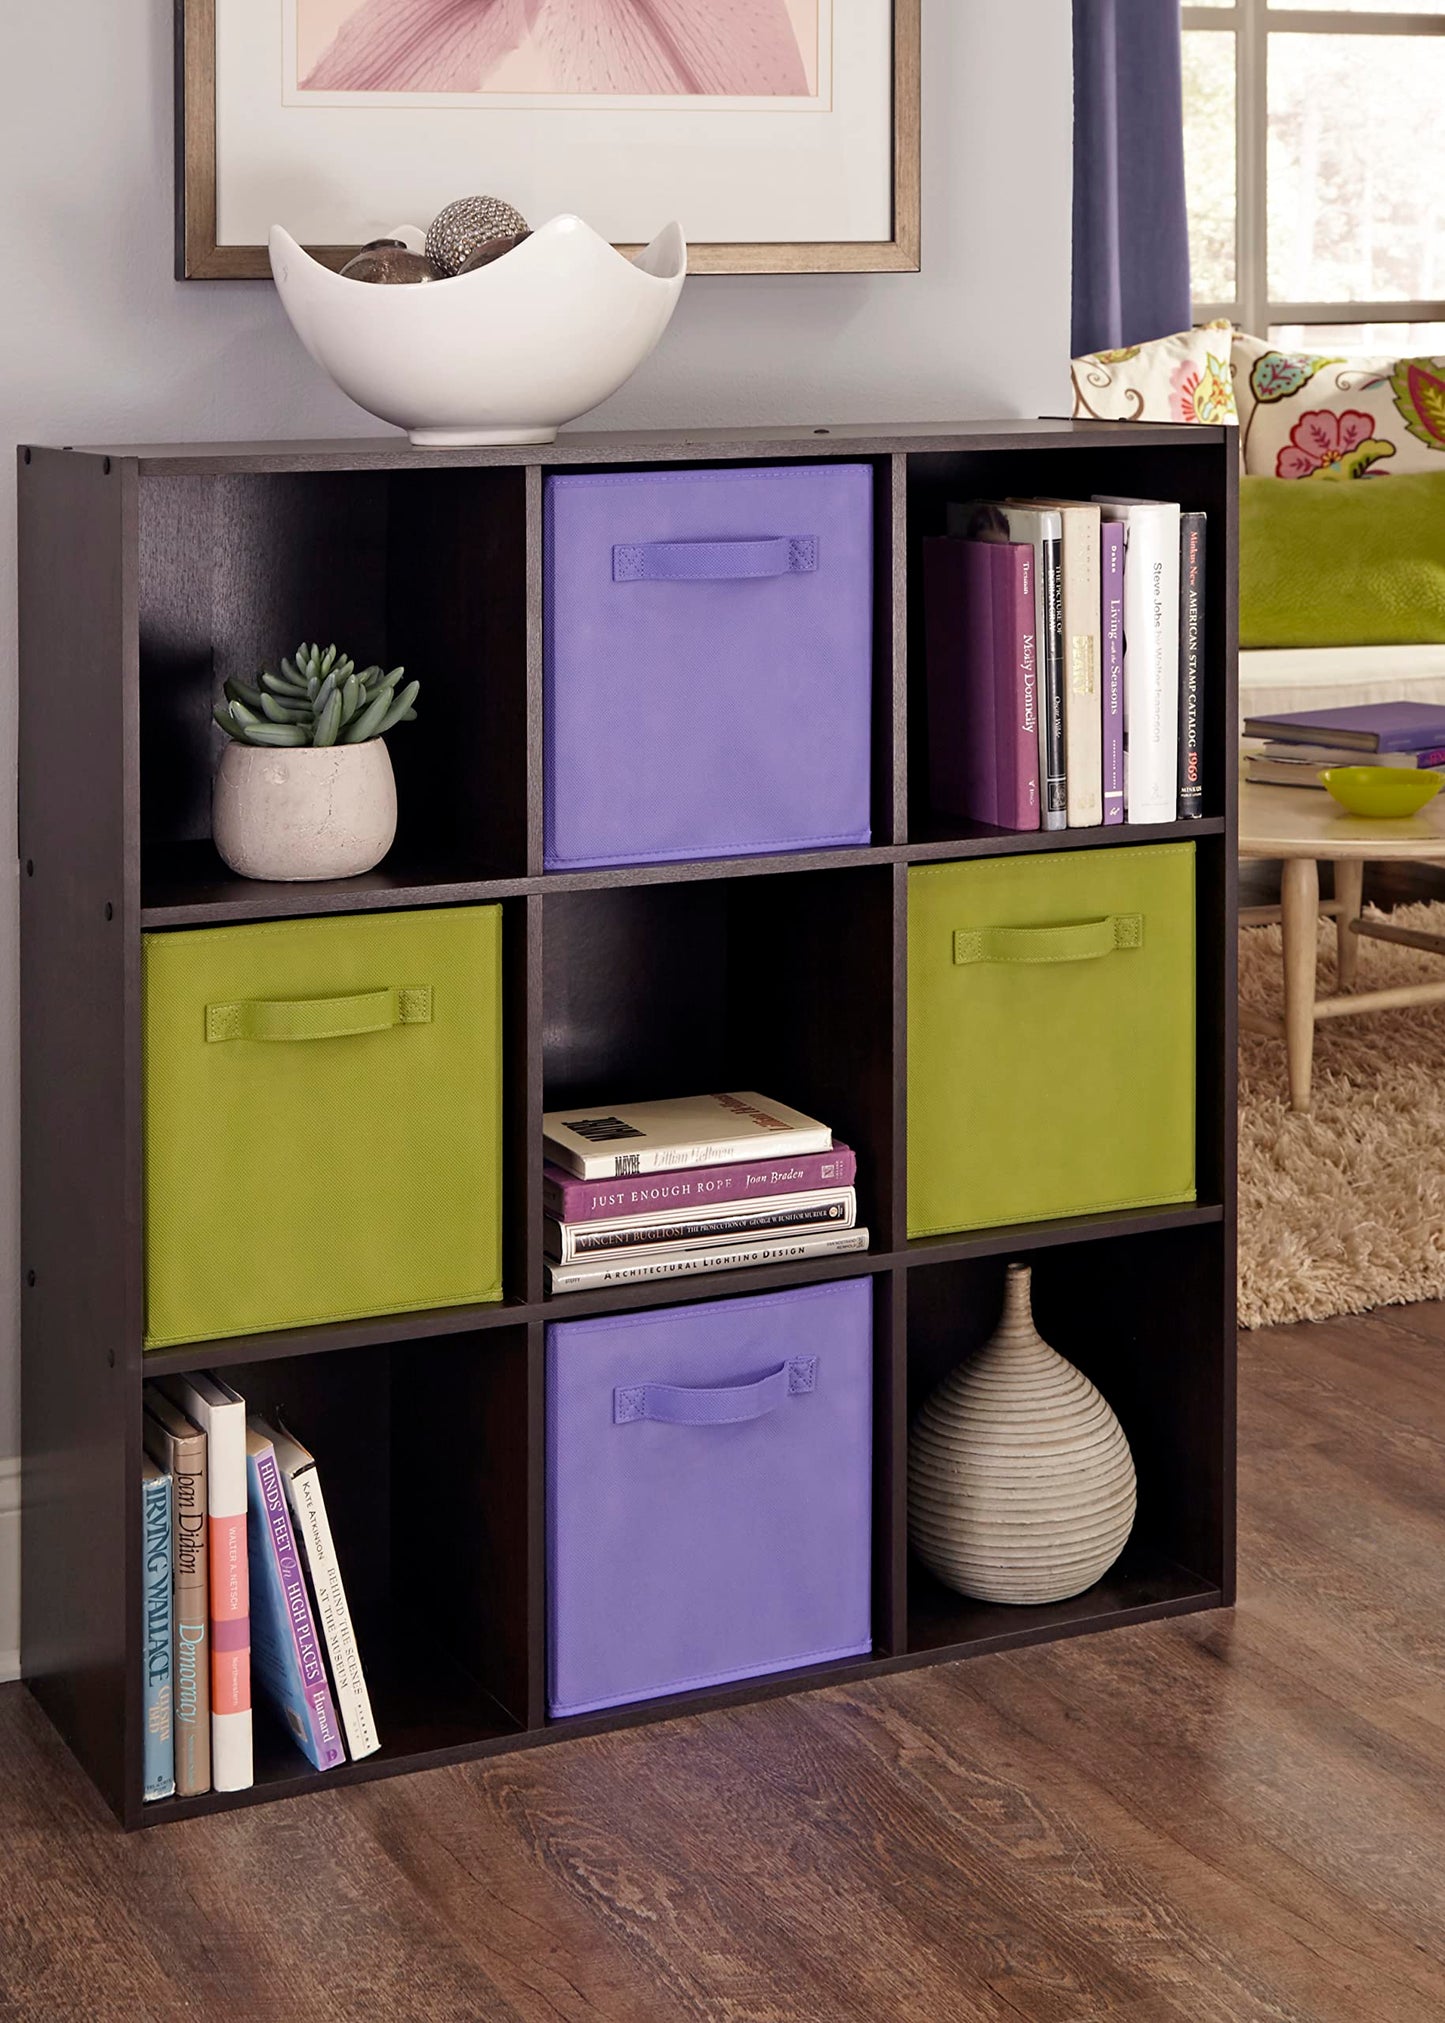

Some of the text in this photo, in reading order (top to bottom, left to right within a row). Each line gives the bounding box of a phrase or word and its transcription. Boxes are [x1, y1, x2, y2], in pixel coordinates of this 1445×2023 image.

[1189, 531, 1199, 564] Minkus
[1153, 562, 1162, 596] Steve
[1189, 566, 1198, 586] New
[1107, 600, 1120, 639] Living
[1153, 599, 1162, 627] Jobs
[1188, 590, 1198, 650] AMERICAN
[1110, 666, 1120, 715] Seasons
[1188, 654, 1197, 691] STAMP
[1188, 694, 1197, 747] CATALOG
[1187, 752, 1198, 781] 1969
[614, 1153, 641, 1177] MAYBE
[746, 1168, 804, 1190] Joan Braden
[591, 1178, 732, 1209] JUST ENOUGH ROPE
[580, 1234, 630, 1248] VINCENT
[633, 1226, 684, 1242] BUGLIOSI
[700, 1221, 739, 1232] PROSECUTION
[804, 1210, 828, 1218] MURDER
[603, 1246, 806, 1280] ARCHITECTURAL LIGHTING DESIGN
[174, 1467, 204, 1574] Joan Didion
[302, 1481, 325, 1560] KATE ATKINSON
[229, 1527, 237, 1561] WALTER
[146, 1484, 170, 1688] IRVING WALLACE
[260, 1462, 321, 1681] HINDS' FEET On HIGH PLACES
[230, 1575, 239, 1611] NETSCH
[319, 1589, 348, 1689] AT THE MUSEUM
[327, 1568, 363, 1695] BEHIND THE SCENES
[176, 1624, 204, 1723] Democracy
[312, 1691, 335, 1743] Hurnard
